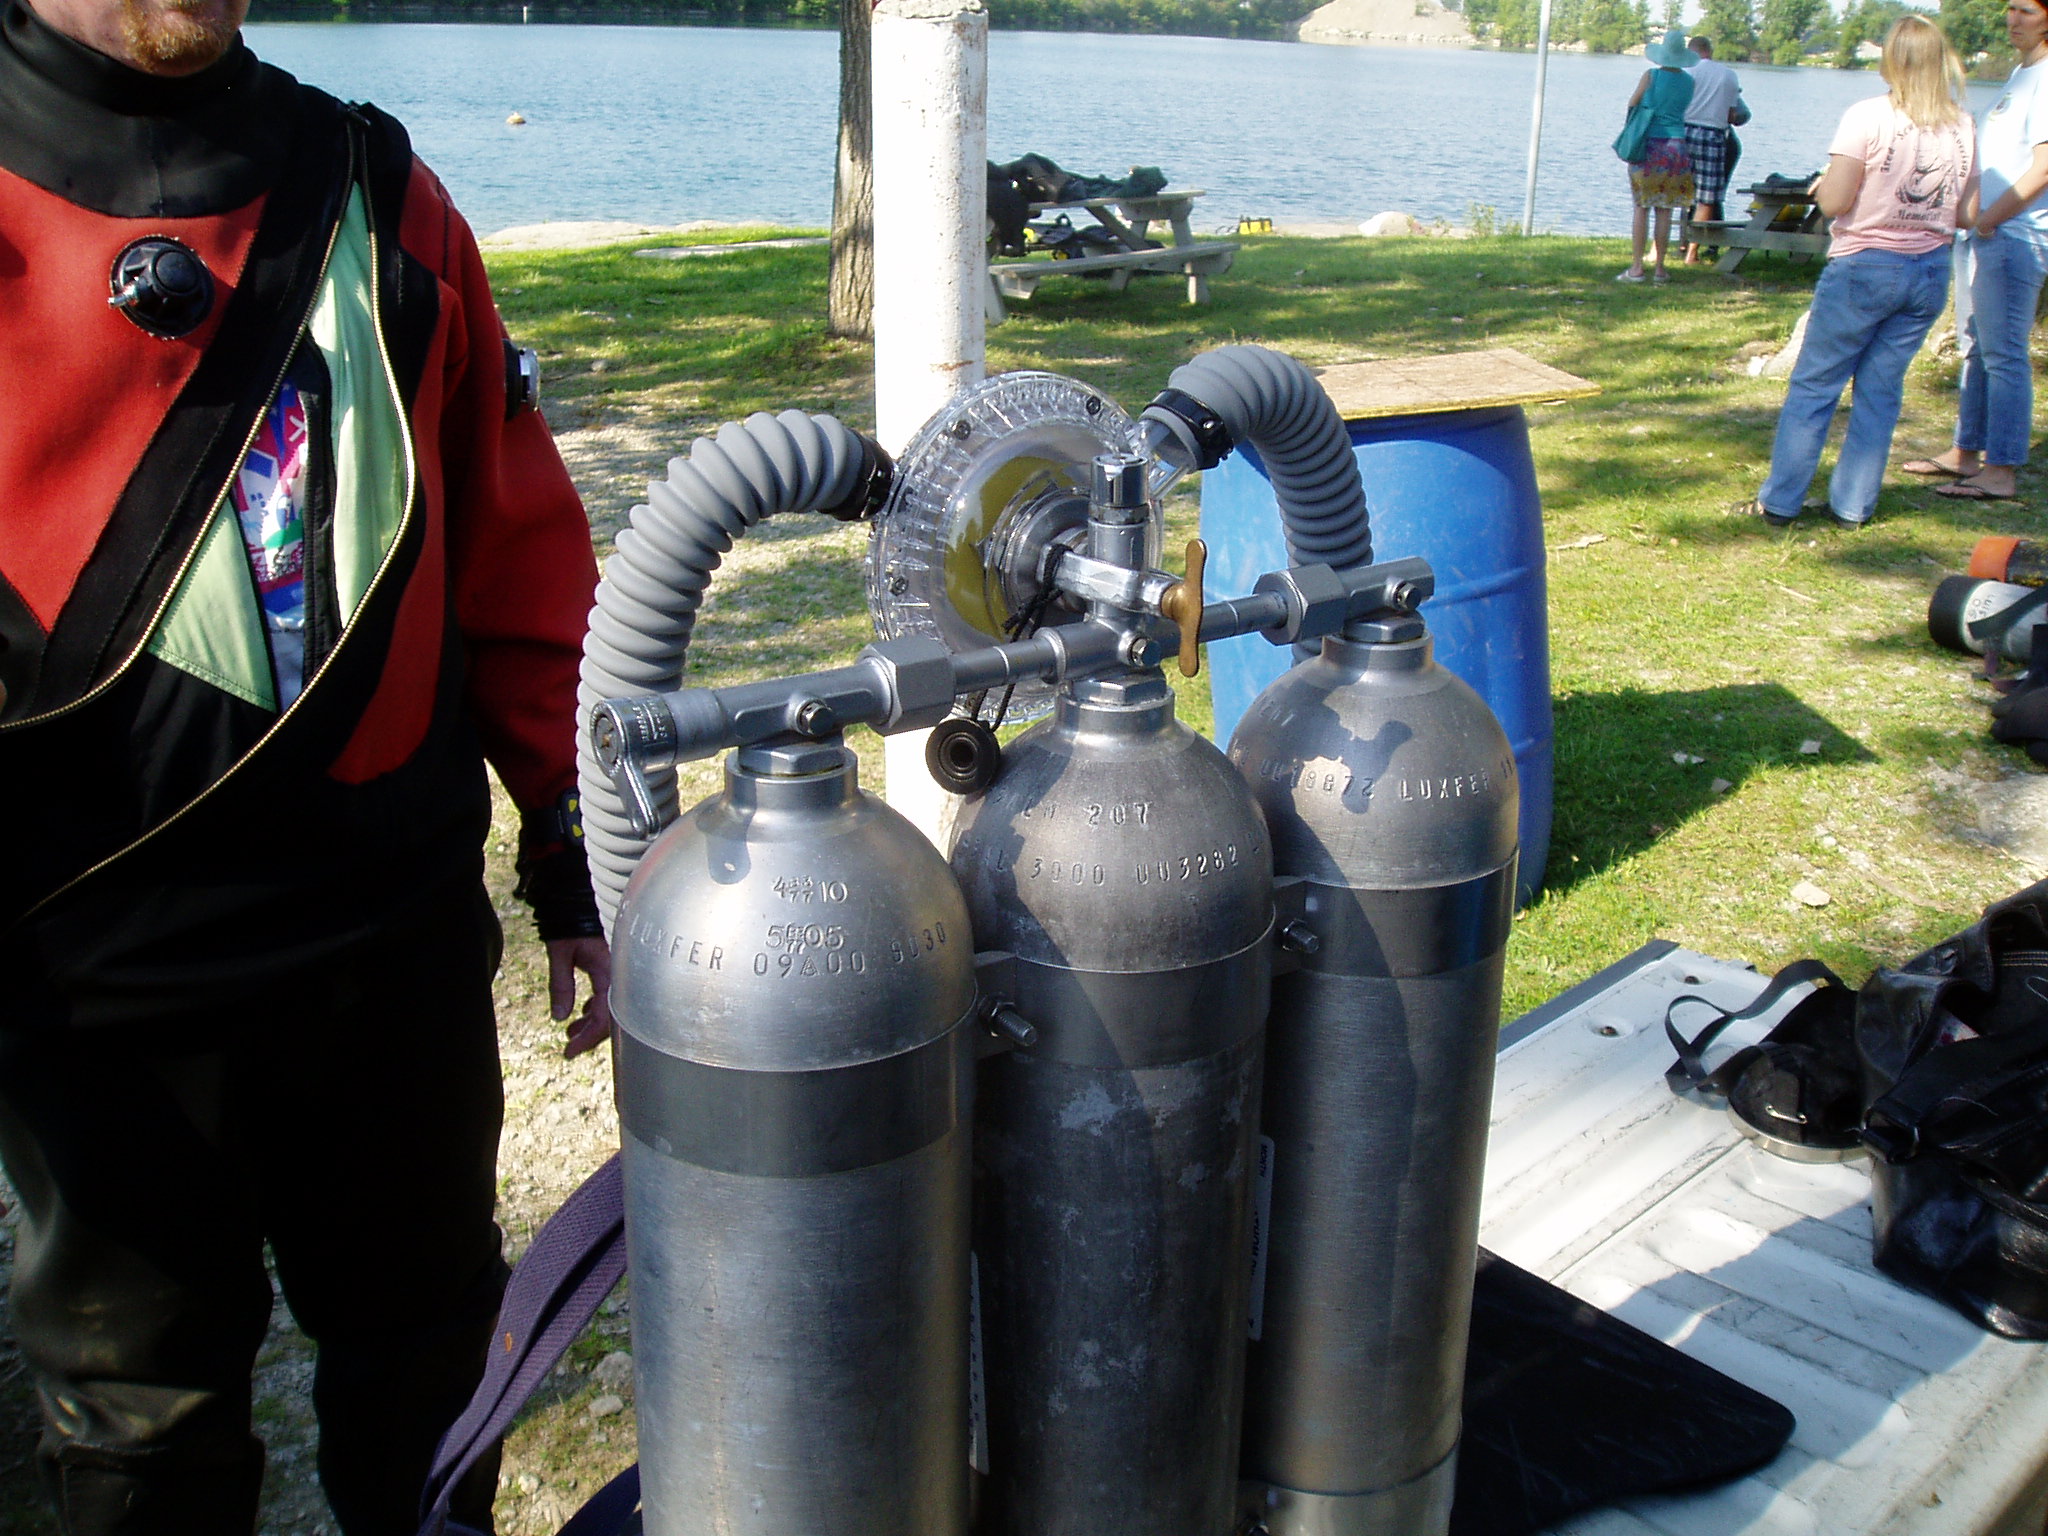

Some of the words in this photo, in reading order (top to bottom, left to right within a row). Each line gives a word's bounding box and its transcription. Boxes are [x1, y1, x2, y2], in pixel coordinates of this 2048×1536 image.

[1085, 801, 1153, 827] 207
[1030, 855, 1106, 886] 3000
[629, 912, 725, 971] LUXFER
